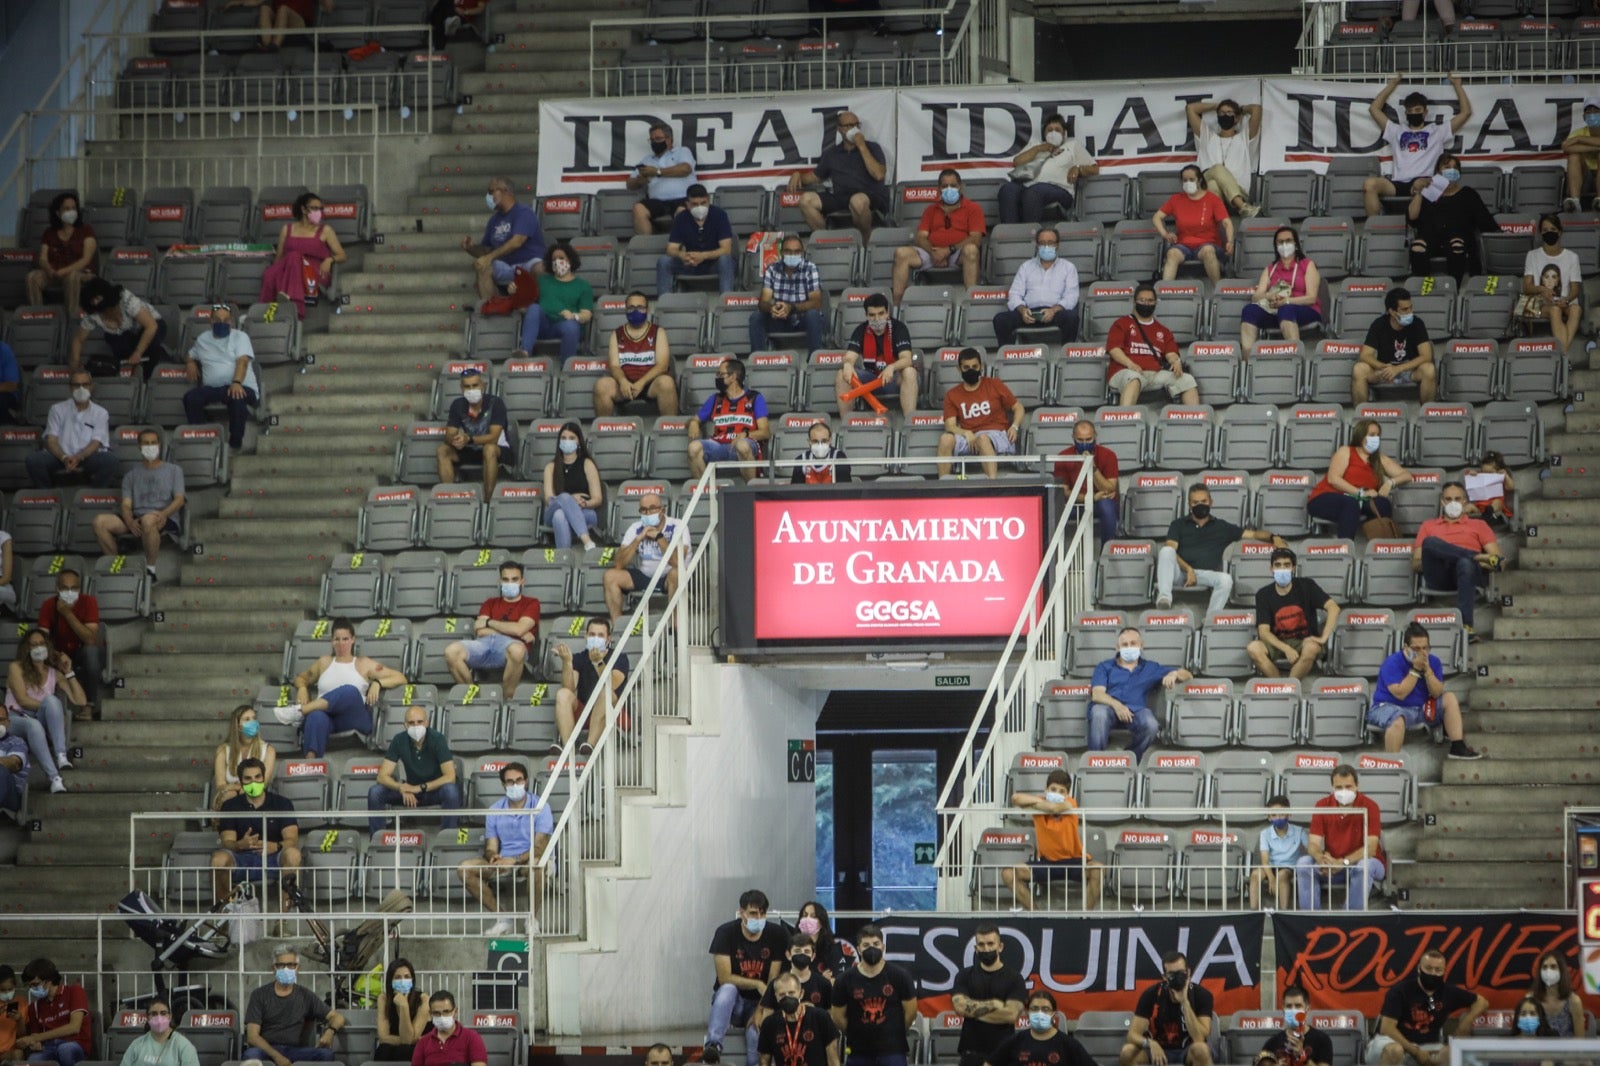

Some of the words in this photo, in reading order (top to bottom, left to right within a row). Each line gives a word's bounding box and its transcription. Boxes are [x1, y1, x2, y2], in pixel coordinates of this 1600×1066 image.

[1513, 225, 1533, 233] USAR
[1327, 345, 1339, 353] NO
[960, 400, 991, 419] Lee
[772, 510, 1026, 543] AYUNTAMIENTO
[793, 562, 836, 585] DE
[846, 551, 1005, 584] GRANADA
[937, 677, 969, 685] SALIDA
[791, 751, 800, 781] C
[804, 751, 813, 781] C
[1037, 759, 1059, 767] USAR
[1092, 758, 1105, 766] NO
[1106, 758, 1127, 766] USAR
[1160, 759, 1173, 767] NO
[1299, 757, 1311, 766] NO
[1313, 759, 1334, 768] USAR
[1364, 759, 1376, 767] NO
[290, 765, 302, 773] NO
[303, 765, 324, 773] USAR
[385, 835, 397, 843] NO
[1139, 835, 1159, 843] USAR
[1195, 834, 1207, 842] NO
[880, 924, 1254, 993] ESQUINA
[208, 1017, 230, 1025] USAR
[1019, 1019, 1031, 1027] NO
[1316, 1019, 1328, 1027] NO
